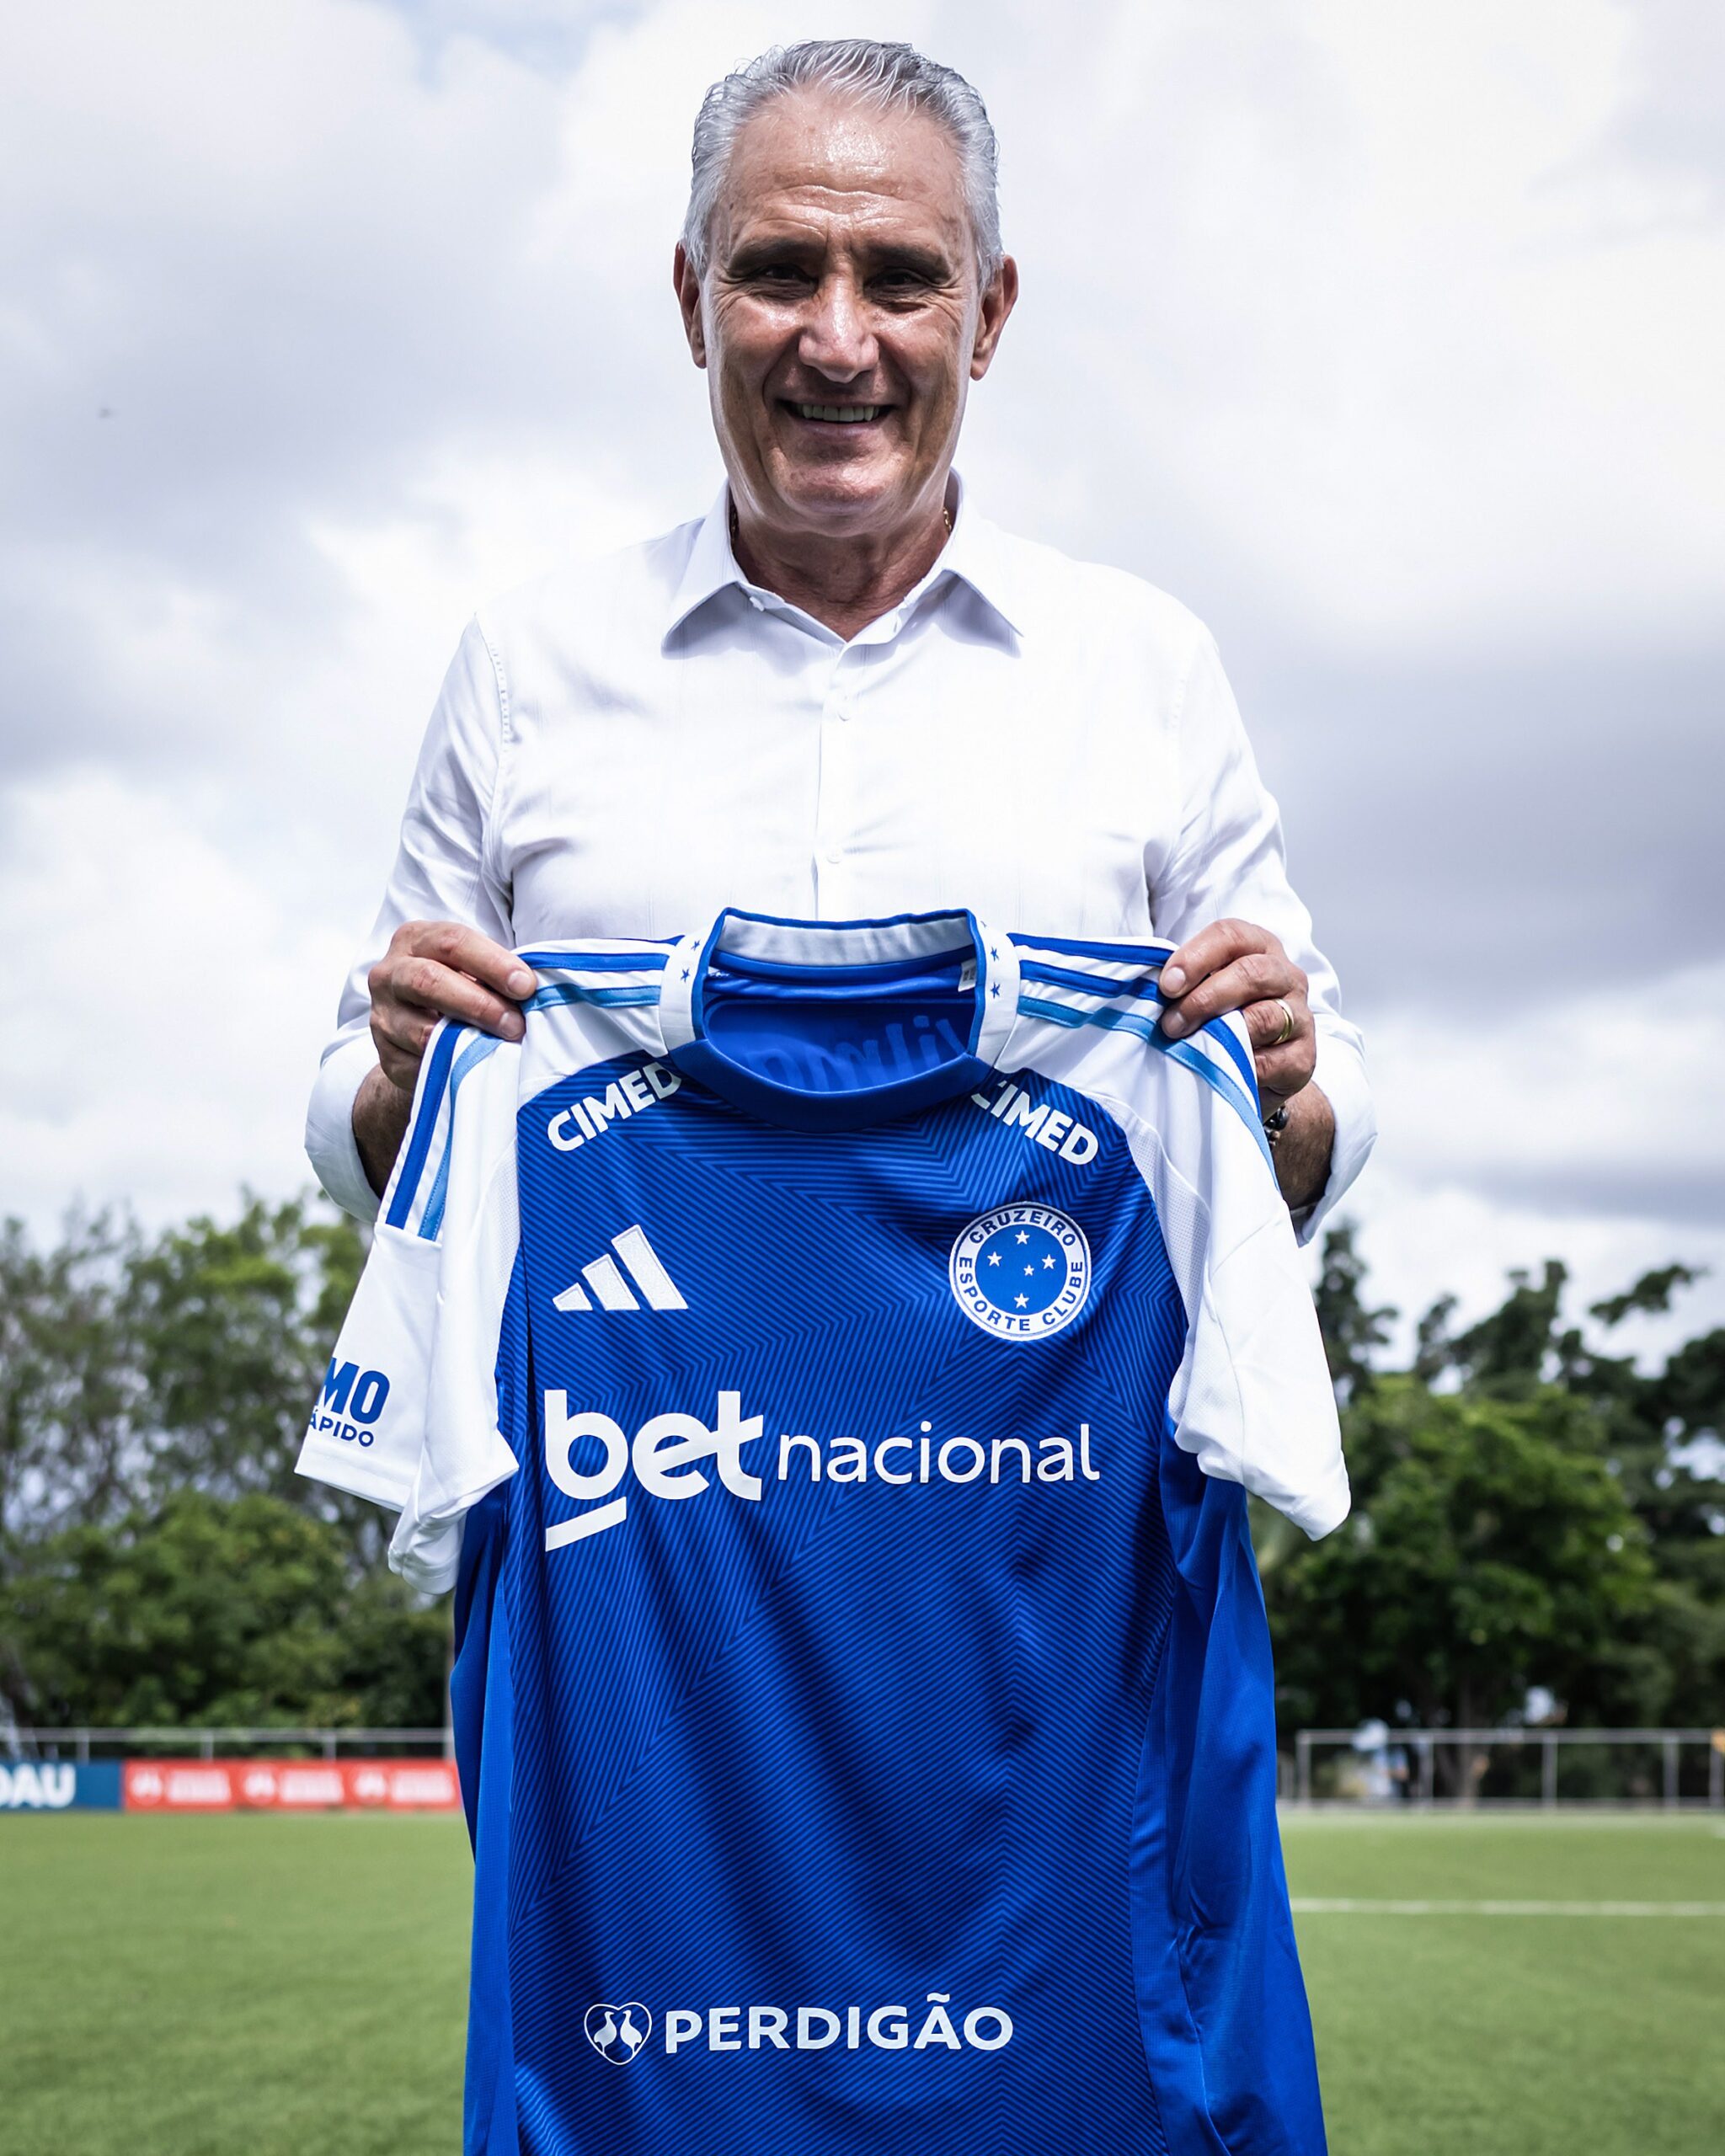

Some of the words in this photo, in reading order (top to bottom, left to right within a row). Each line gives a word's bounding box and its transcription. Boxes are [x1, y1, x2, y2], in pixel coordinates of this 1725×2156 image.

[547, 1062, 682, 1151] CIMED
[969, 1209, 1076, 1247] CRUZEIRO
[959, 1257, 1031, 1331] ESPORTE
[1041, 1261, 1083, 1326] CLUBE
[544, 1389, 764, 1501] bet
[777, 1420, 1100, 1485] nacional
[665, 1992, 1014, 2054] PERDIGÃO
